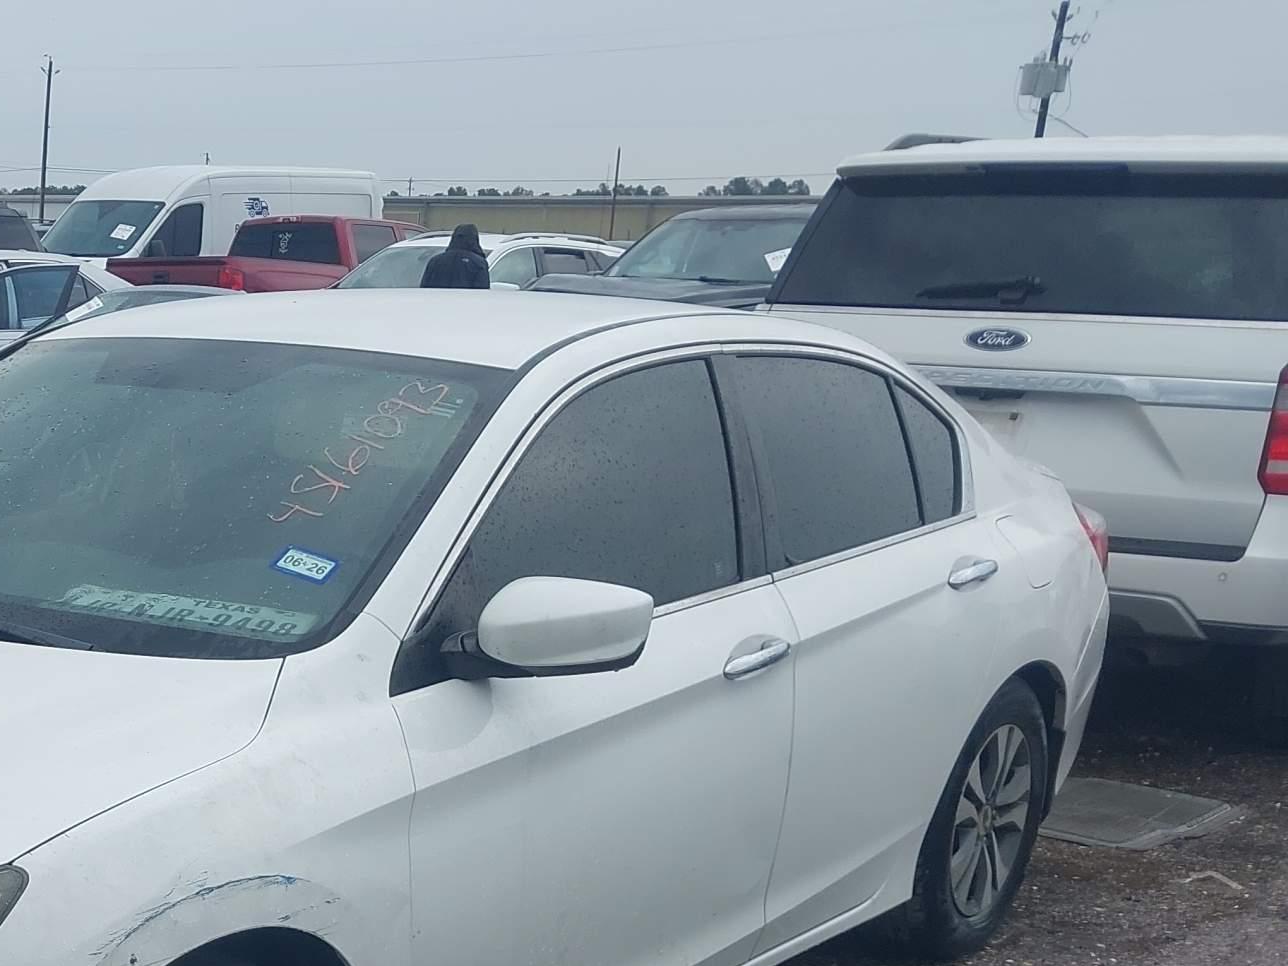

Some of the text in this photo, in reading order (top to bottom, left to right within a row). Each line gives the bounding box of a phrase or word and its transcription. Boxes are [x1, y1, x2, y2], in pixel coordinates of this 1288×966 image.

[976, 330, 1016, 346] Ford
[282, 554, 304, 567] 06
[306, 562, 328, 576] 26
[193, 599, 261, 615] TEXAS
